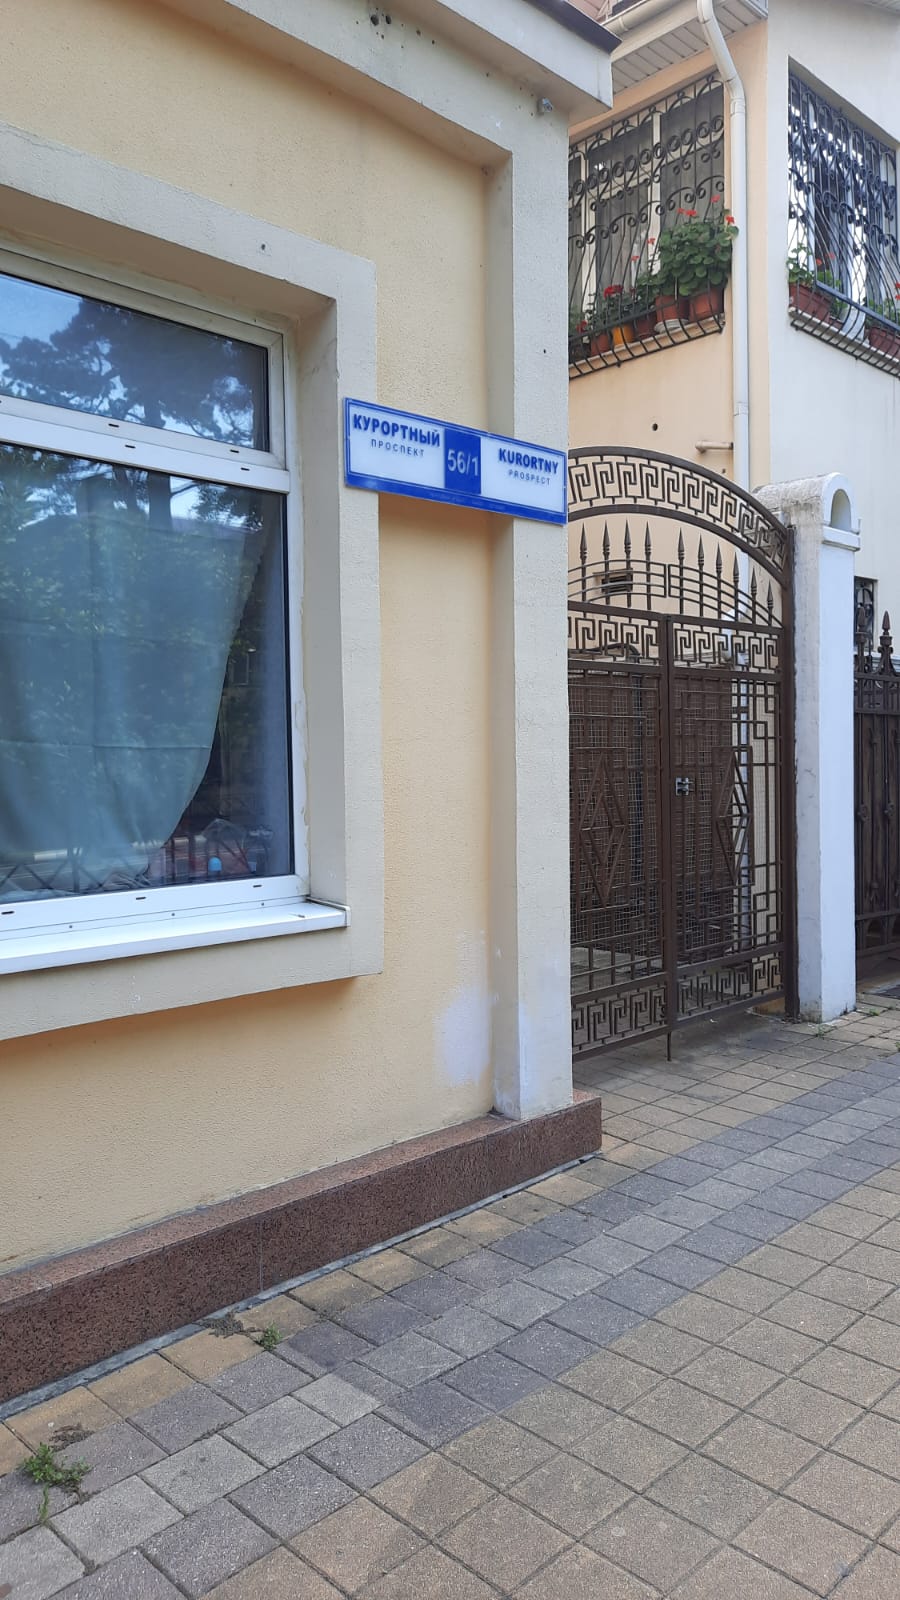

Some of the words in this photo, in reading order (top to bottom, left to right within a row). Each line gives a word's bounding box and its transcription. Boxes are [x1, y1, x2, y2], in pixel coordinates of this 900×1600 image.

[353, 414, 440, 447] КУРОРТНЫЙ
[371, 438, 424, 457] ПРОСПЕКТ
[447, 449, 479, 476] 56/1
[499, 448, 559, 475] KURORTNY
[508, 469, 551, 485] PROSPECT
